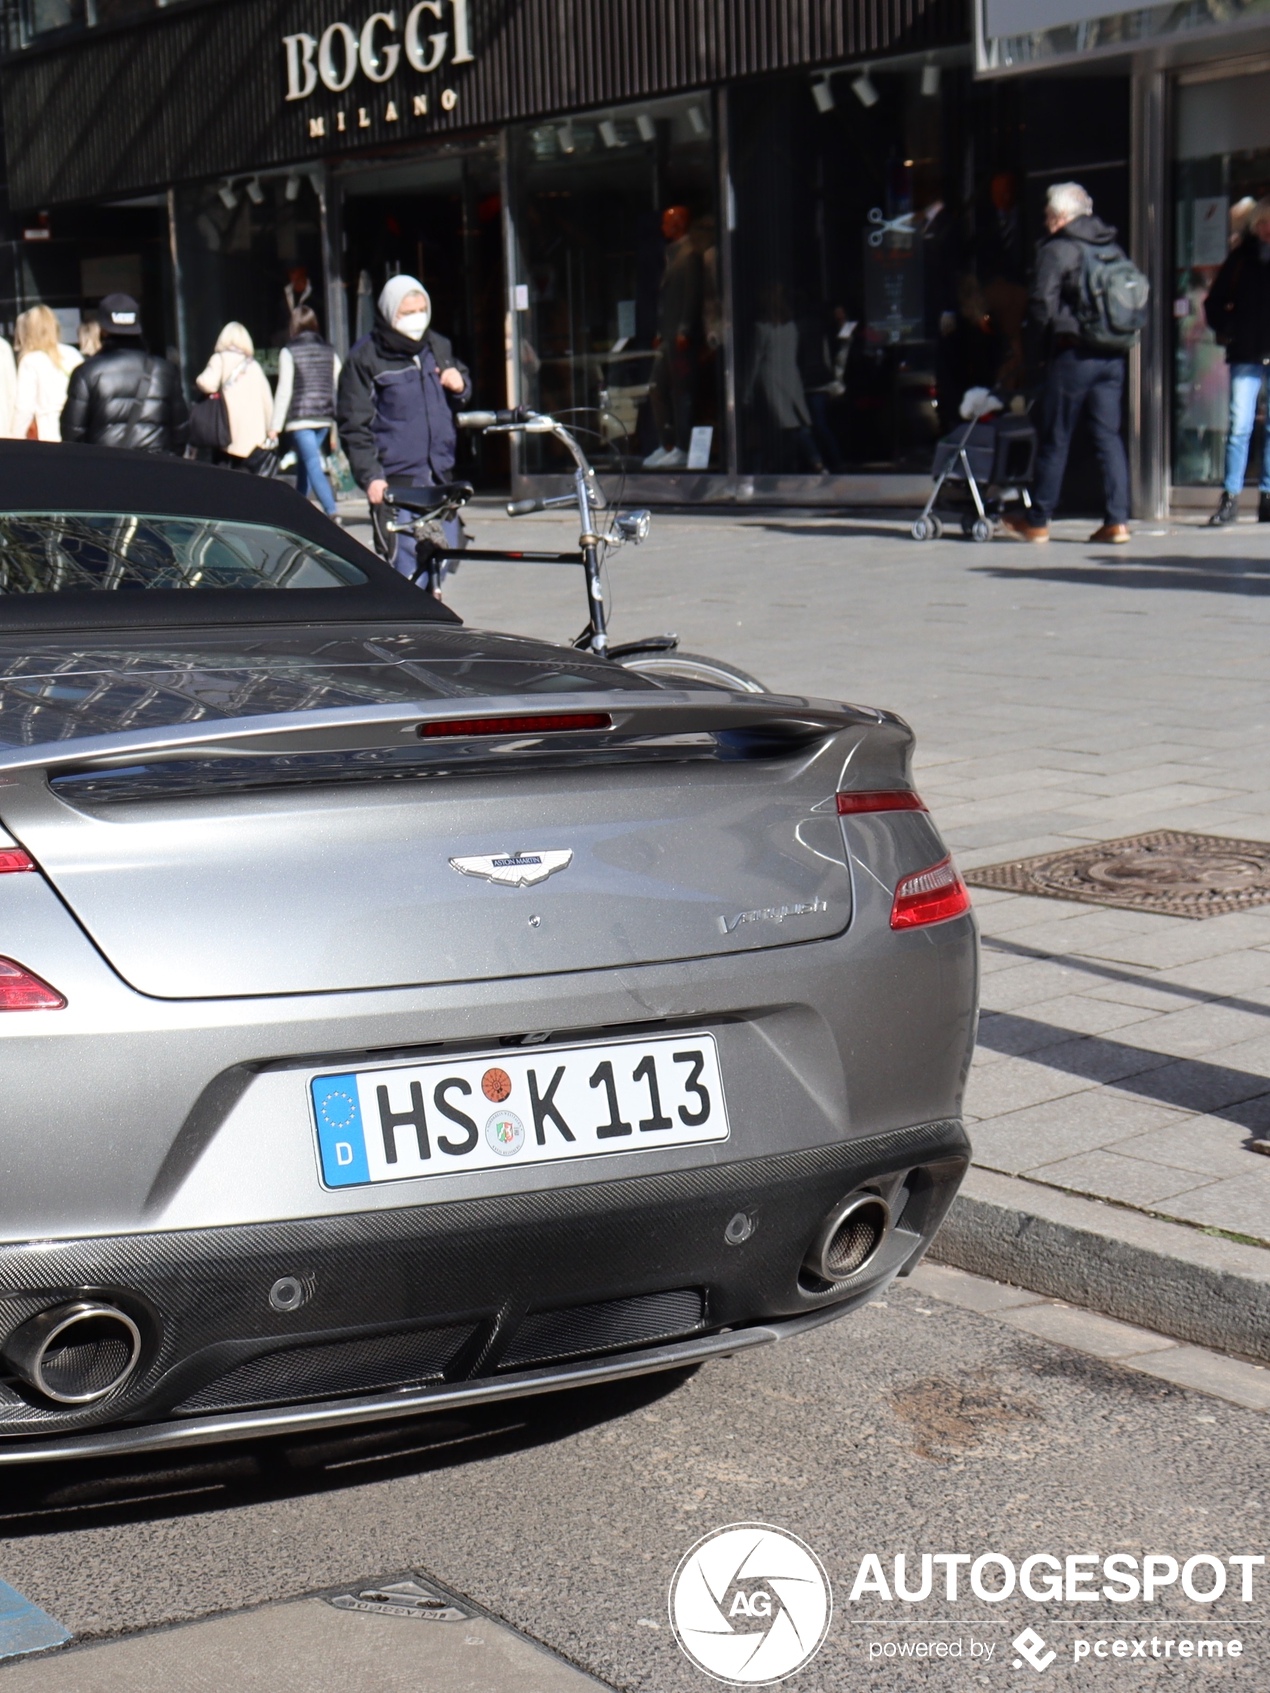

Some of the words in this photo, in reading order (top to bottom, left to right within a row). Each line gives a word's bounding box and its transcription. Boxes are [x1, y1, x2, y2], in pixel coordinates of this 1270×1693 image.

[282, 0, 475, 102] BOGGI
[309, 88, 458, 138] MILANO
[493, 859, 516, 867] ASTON
[516, 857, 541, 865] MARTIN
[718, 896, 828, 934] Vanquish
[376, 1077, 479, 1164] HS
[527, 1066, 576, 1146] K
[588, 1050, 711, 1139] 113
[335, 1142, 353, 1166] D
